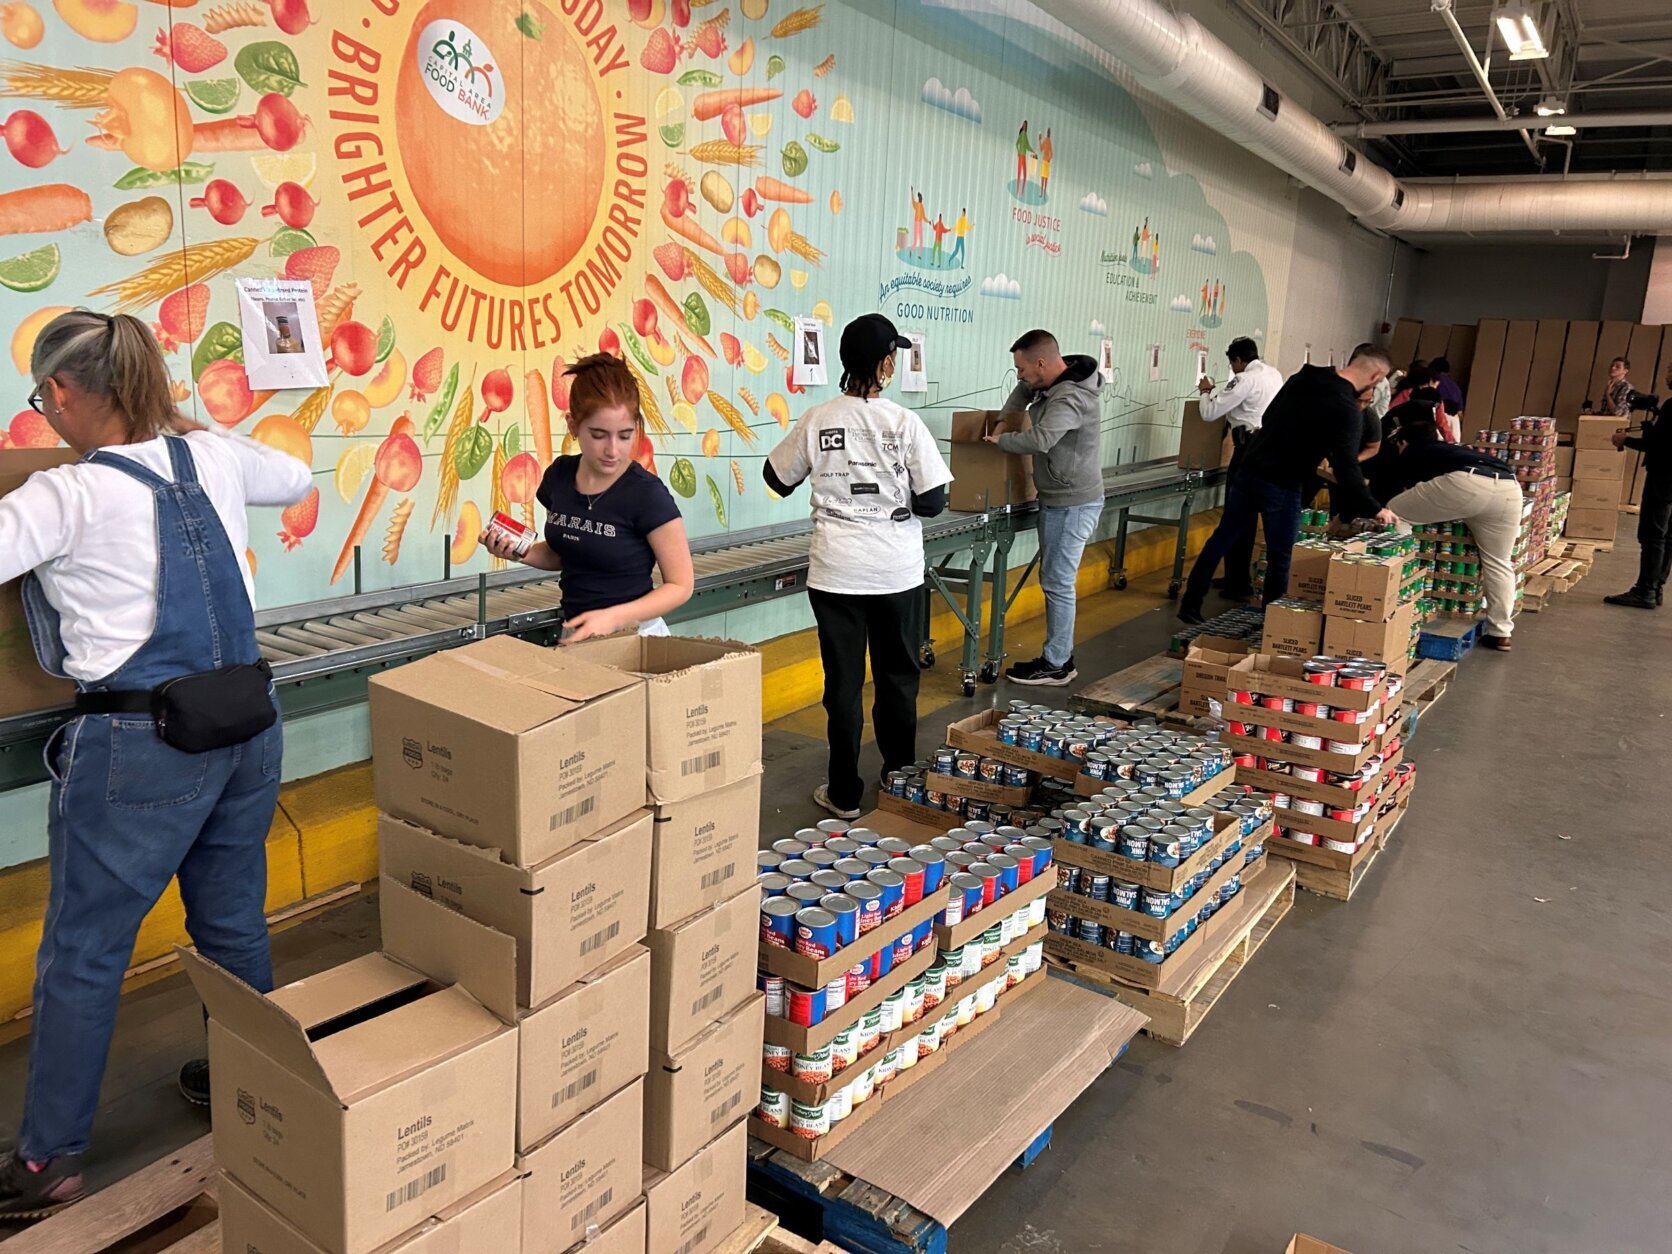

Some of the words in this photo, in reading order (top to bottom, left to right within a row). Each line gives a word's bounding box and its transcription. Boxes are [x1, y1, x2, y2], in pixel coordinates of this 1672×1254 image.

[424, 62, 455, 92] FOOD
[457, 88, 489, 121] BANK
[428, 56, 463, 88] CAPITAL
[468, 88, 491, 109] AREA
[328, 29, 427, 290] BRIGHTER
[418, 263, 562, 351] FUTURES
[559, 111, 649, 329] TOMORROW
[1012, 207, 1032, 224] FOOD
[1033, 213, 1061, 232] JUSTICE
[880, 282, 891, 303] An
[890, 272, 922, 291] equitable
[922, 279, 945, 298] society
[945, 275, 972, 298] requires
[897, 303, 925, 319] GOOD
[926, 306, 974, 323] NUTRITION
[820, 433, 843, 450] DC
[1335, 600, 1356, 608] BARTLETT
[1356, 603, 1372, 611] PEARS
[1346, 594, 1363, 602] SLICED
[1272, 643, 1292, 651] BARTLETT
[1292, 646, 1307, 654] PEARS
[1283, 637, 1298, 646] SLICED
[1346, 649, 1363, 657] SLICED
[686, 704, 708, 718] Lentils
[426, 740, 452, 761] Lentils
[560, 751, 585, 769] Lentils
[695, 821, 715, 836] Lentils
[1131, 847, 1146, 855] PINK
[437, 875, 463, 895] Lentils
[572, 882, 595, 902] Lentils
[1145, 896, 1170, 905] SALMON
[1150, 903, 1165, 911] PINK
[702, 944, 720, 961] Lentils
[805, 945, 825, 956] Beans
[562, 1027, 587, 1048] Lentils
[705, 1058, 723, 1077] Lentils
[398, 1115, 432, 1140] Lentils
[397, 1141, 410, 1152] PO#
[397, 1148, 419, 1164] Packed
[432, 1130, 455, 1146] Legume
[561, 1160, 585, 1182] Lentils
[681, 1191, 701, 1211] Lentils
